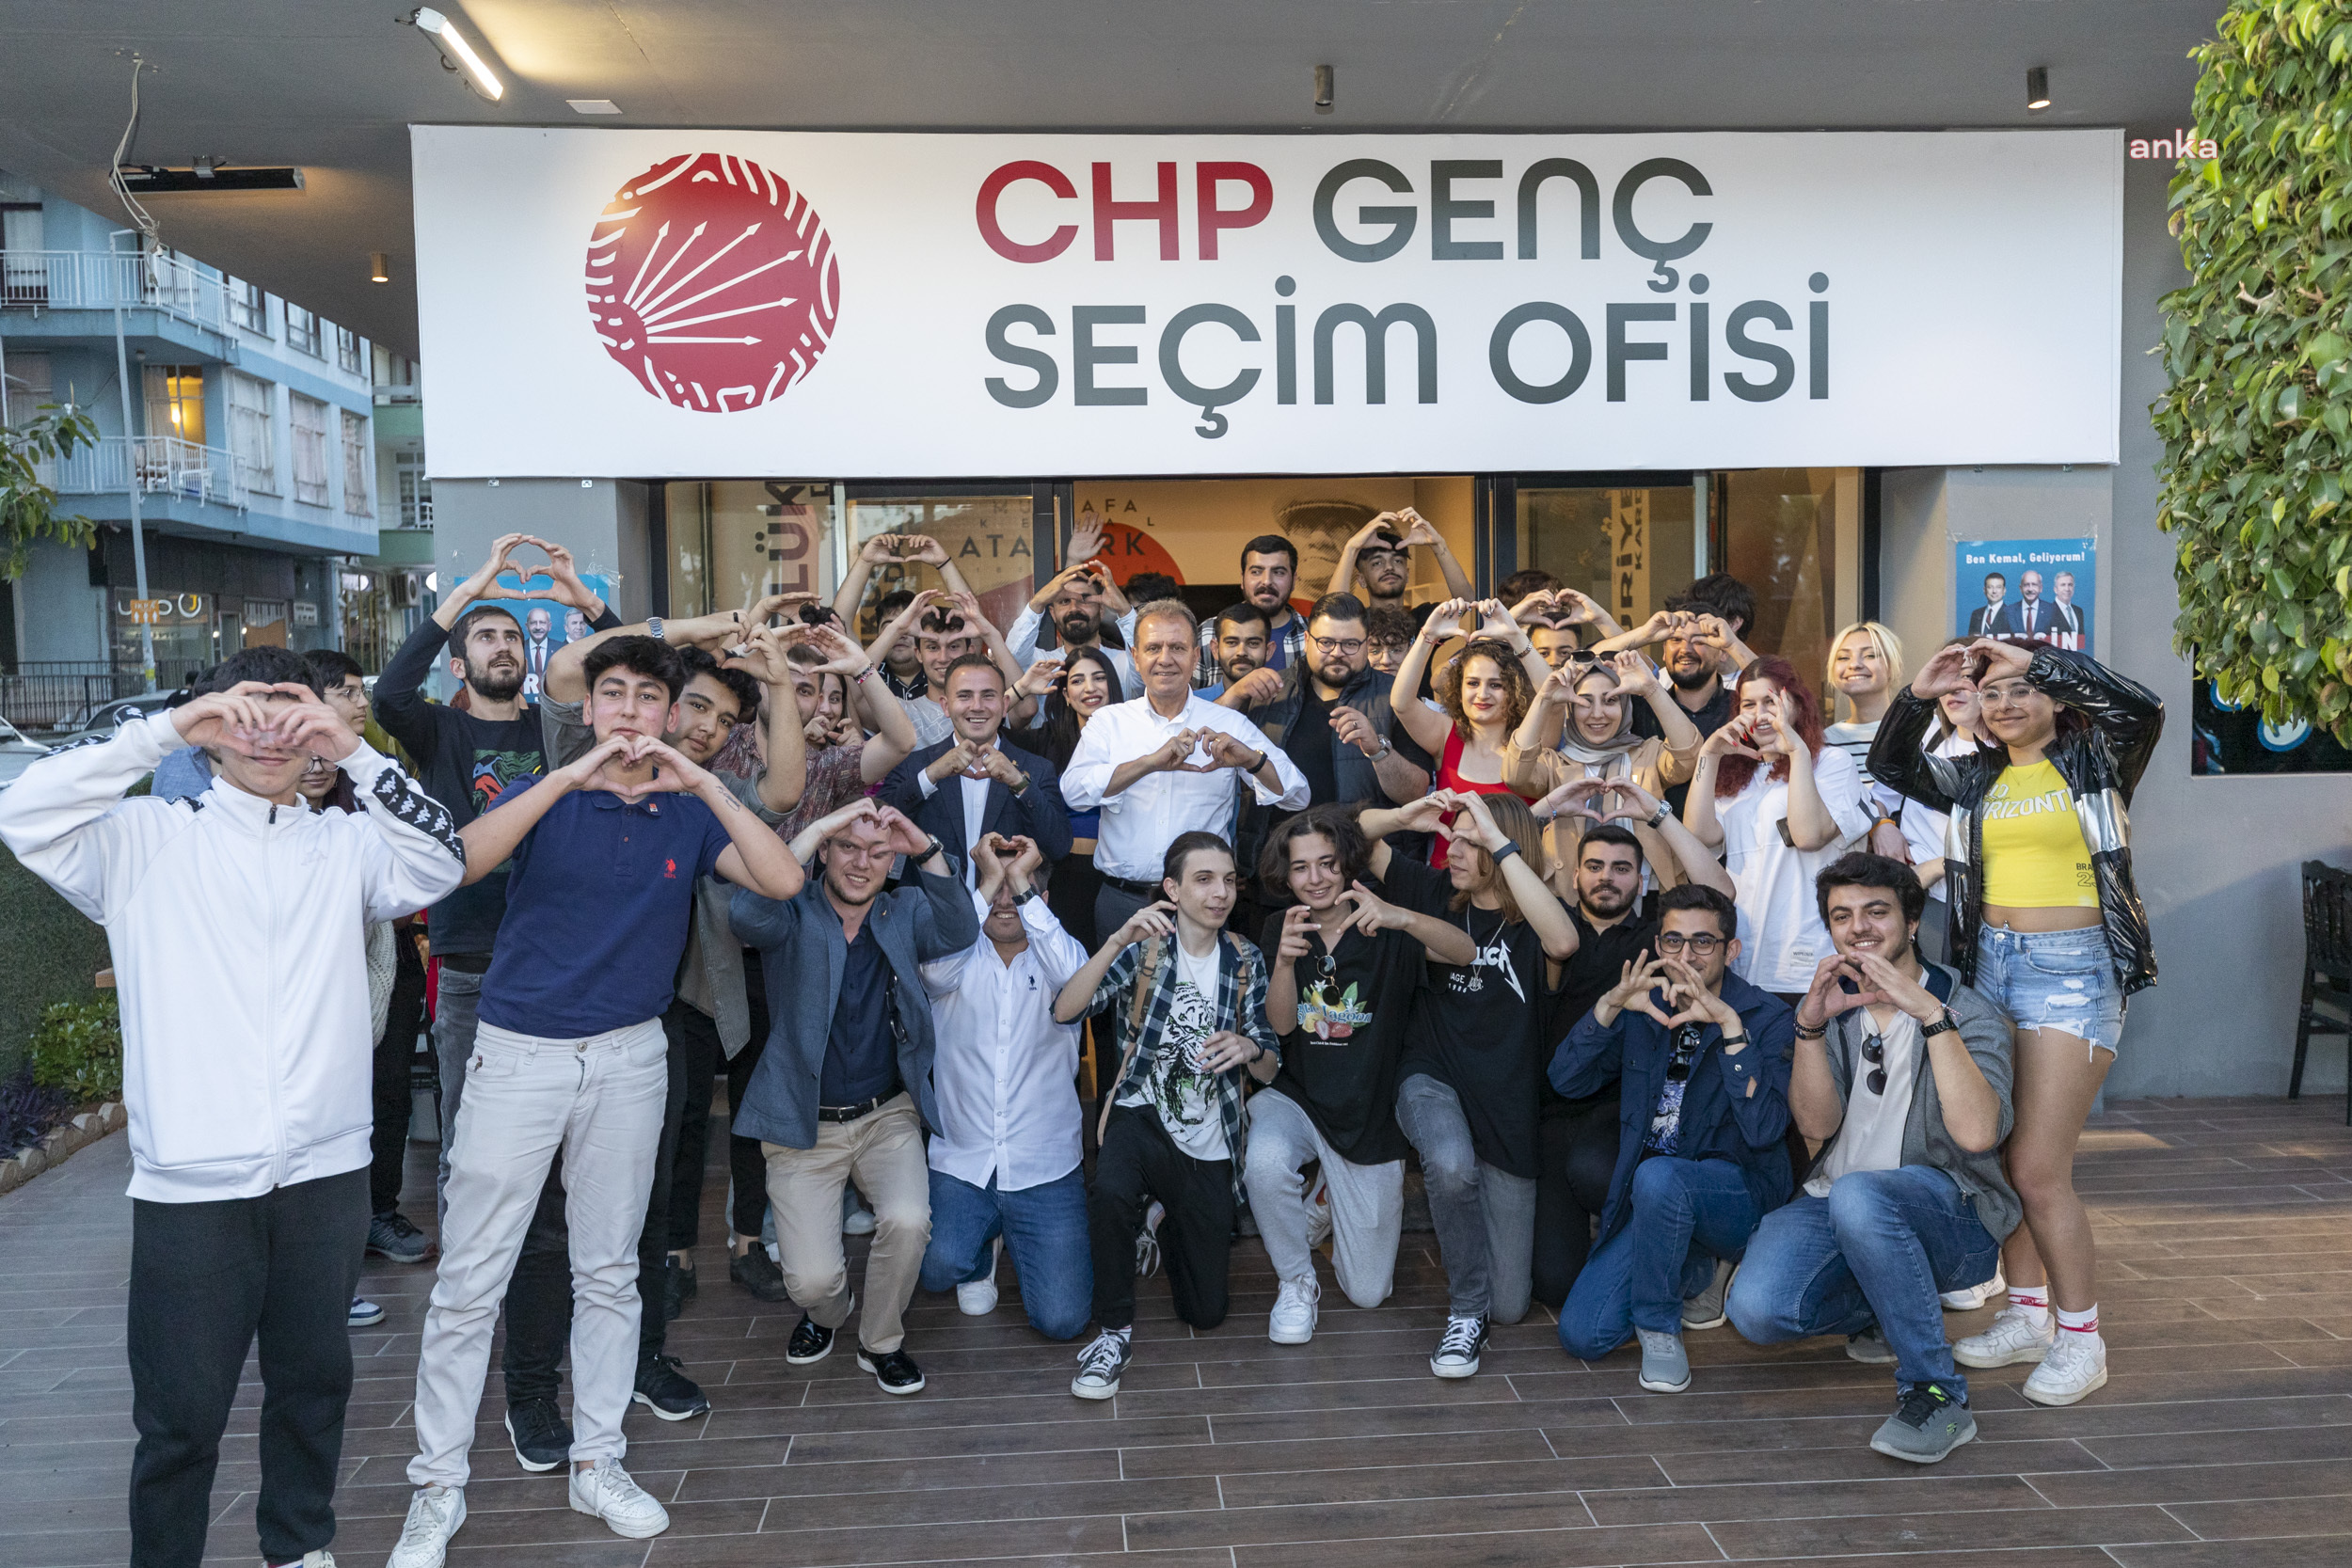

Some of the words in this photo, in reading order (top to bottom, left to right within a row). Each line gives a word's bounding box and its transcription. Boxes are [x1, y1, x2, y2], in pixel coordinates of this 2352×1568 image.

[976, 159, 1274, 264] CHP
[1312, 156, 1714, 293] GENÇ
[984, 275, 1438, 439] SEÇİM
[1488, 271, 1830, 405] OFİSİ
[755, 482, 809, 628] LÜK
[1965, 554, 1986, 564] Ben
[1989, 553, 2026, 563] Kemal,
[2029, 551, 2086, 563] Geliyorum!
